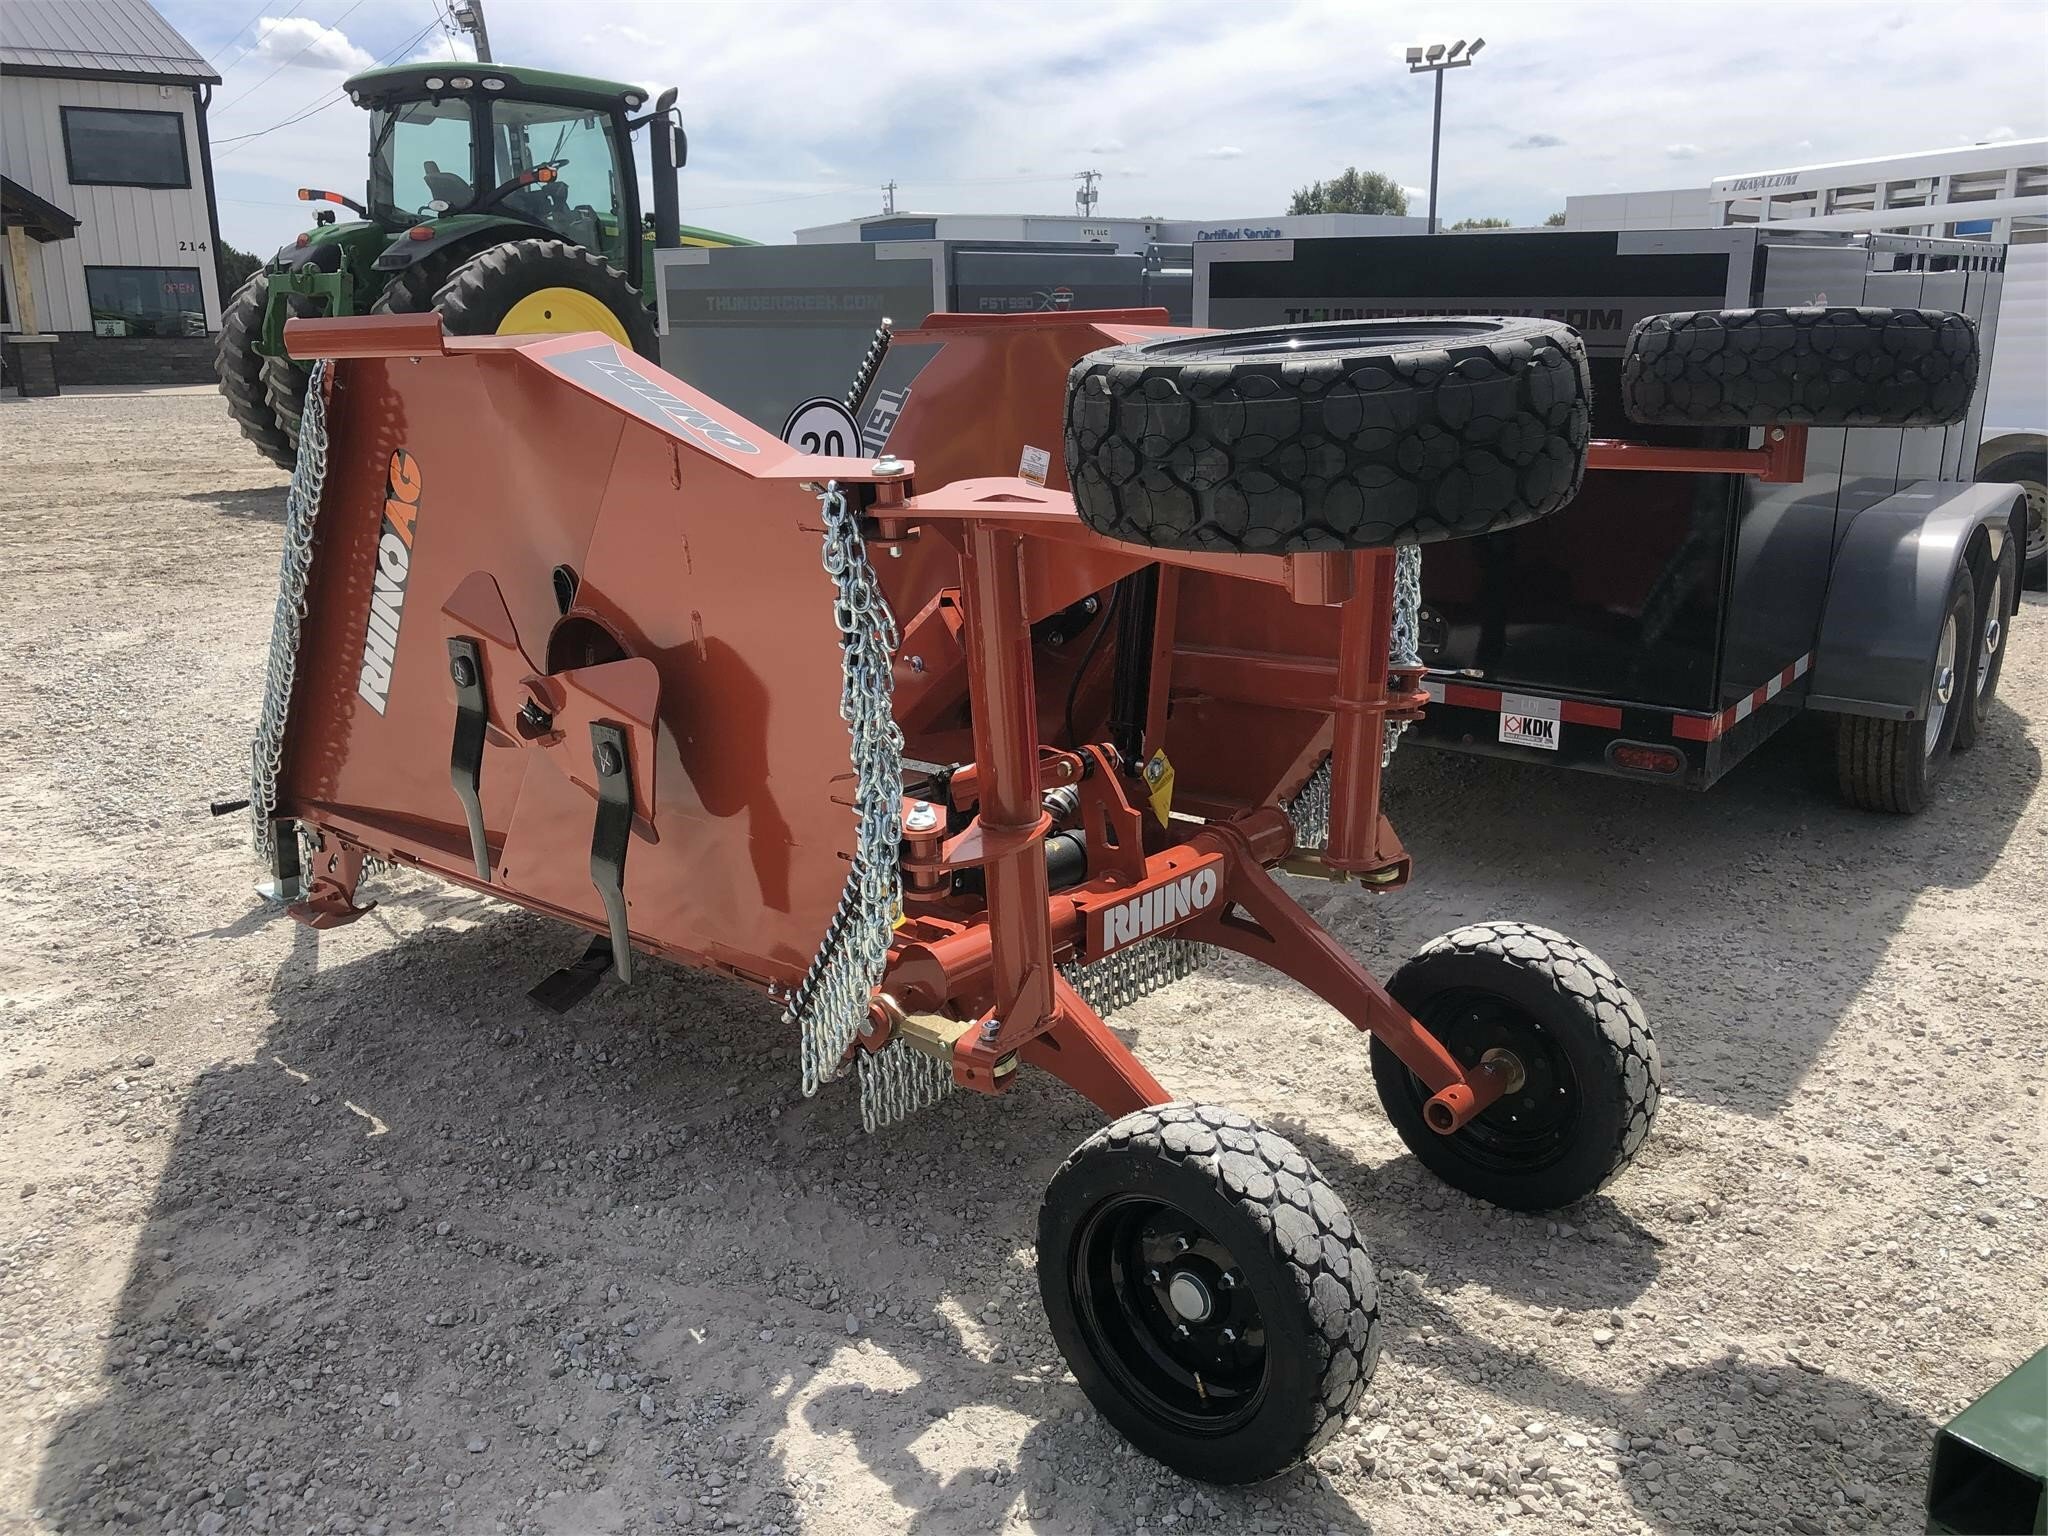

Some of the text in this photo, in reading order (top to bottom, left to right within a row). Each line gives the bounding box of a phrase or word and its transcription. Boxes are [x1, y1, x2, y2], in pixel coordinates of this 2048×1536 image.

[1732, 174, 1799, 192] TRAVALUM
[1197, 227, 1281, 240] Certified Service
[179, 241, 207, 252] 214
[164, 283, 195, 294] OPEN
[1522, 717, 1554, 739] KDK
[1103, 868, 1217, 952] RHINO
